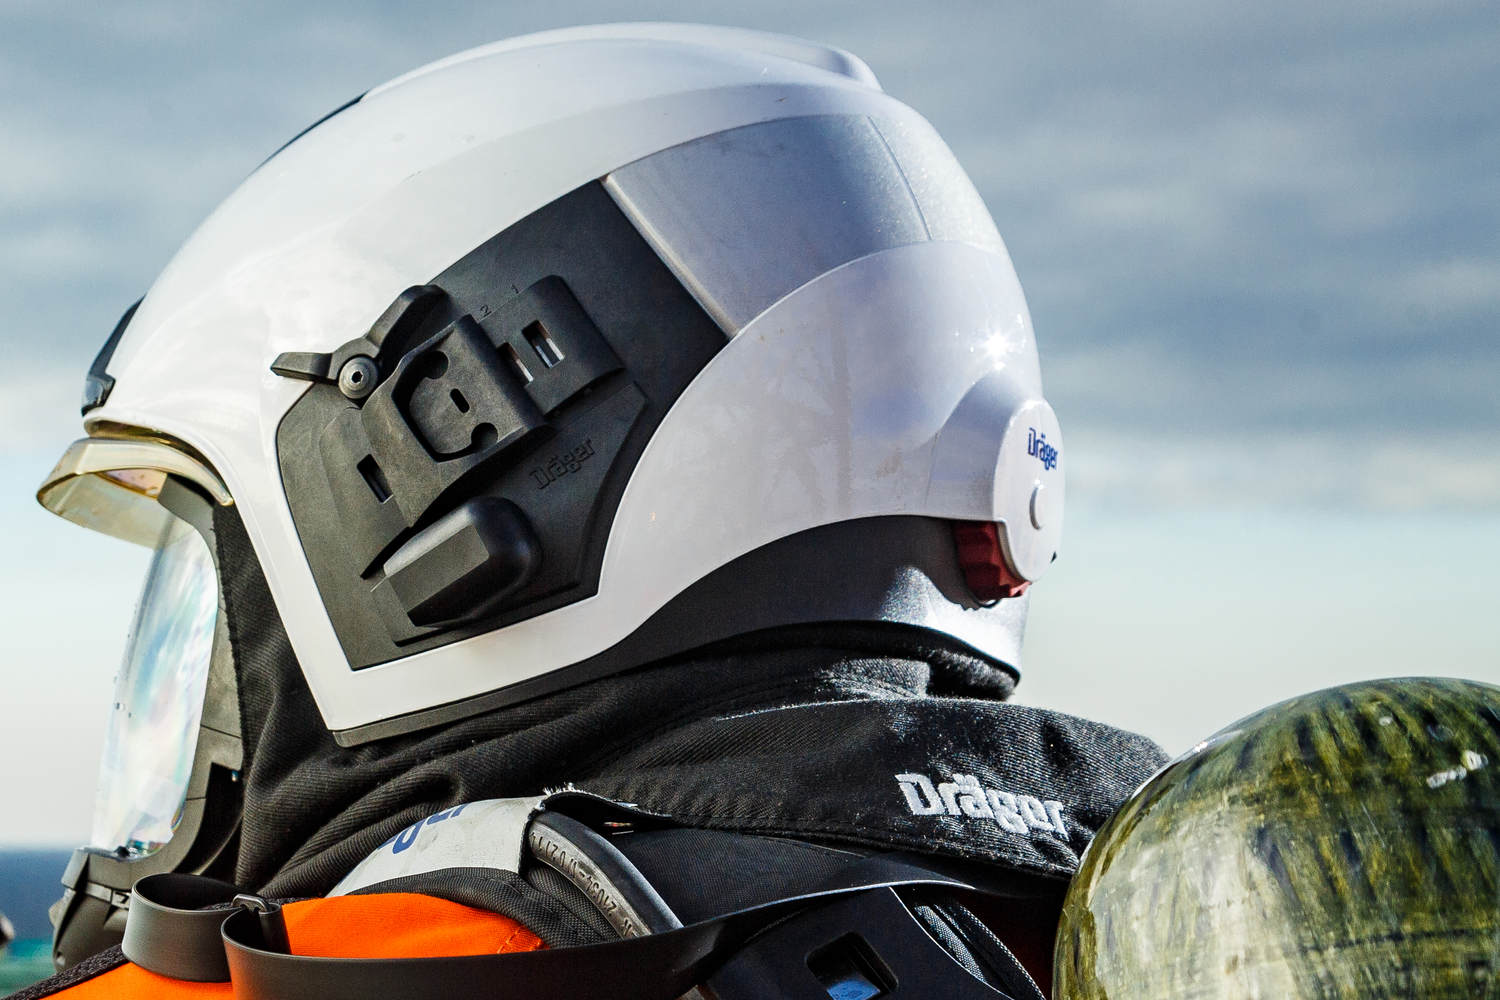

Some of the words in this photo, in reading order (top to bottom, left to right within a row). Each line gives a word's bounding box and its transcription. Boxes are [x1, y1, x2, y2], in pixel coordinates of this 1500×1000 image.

[480, 305, 492, 317] 2
[529, 438, 595, 490] Dräger
[1028, 427, 1058, 470] Dräger
[895, 773, 1070, 842] Dräger
